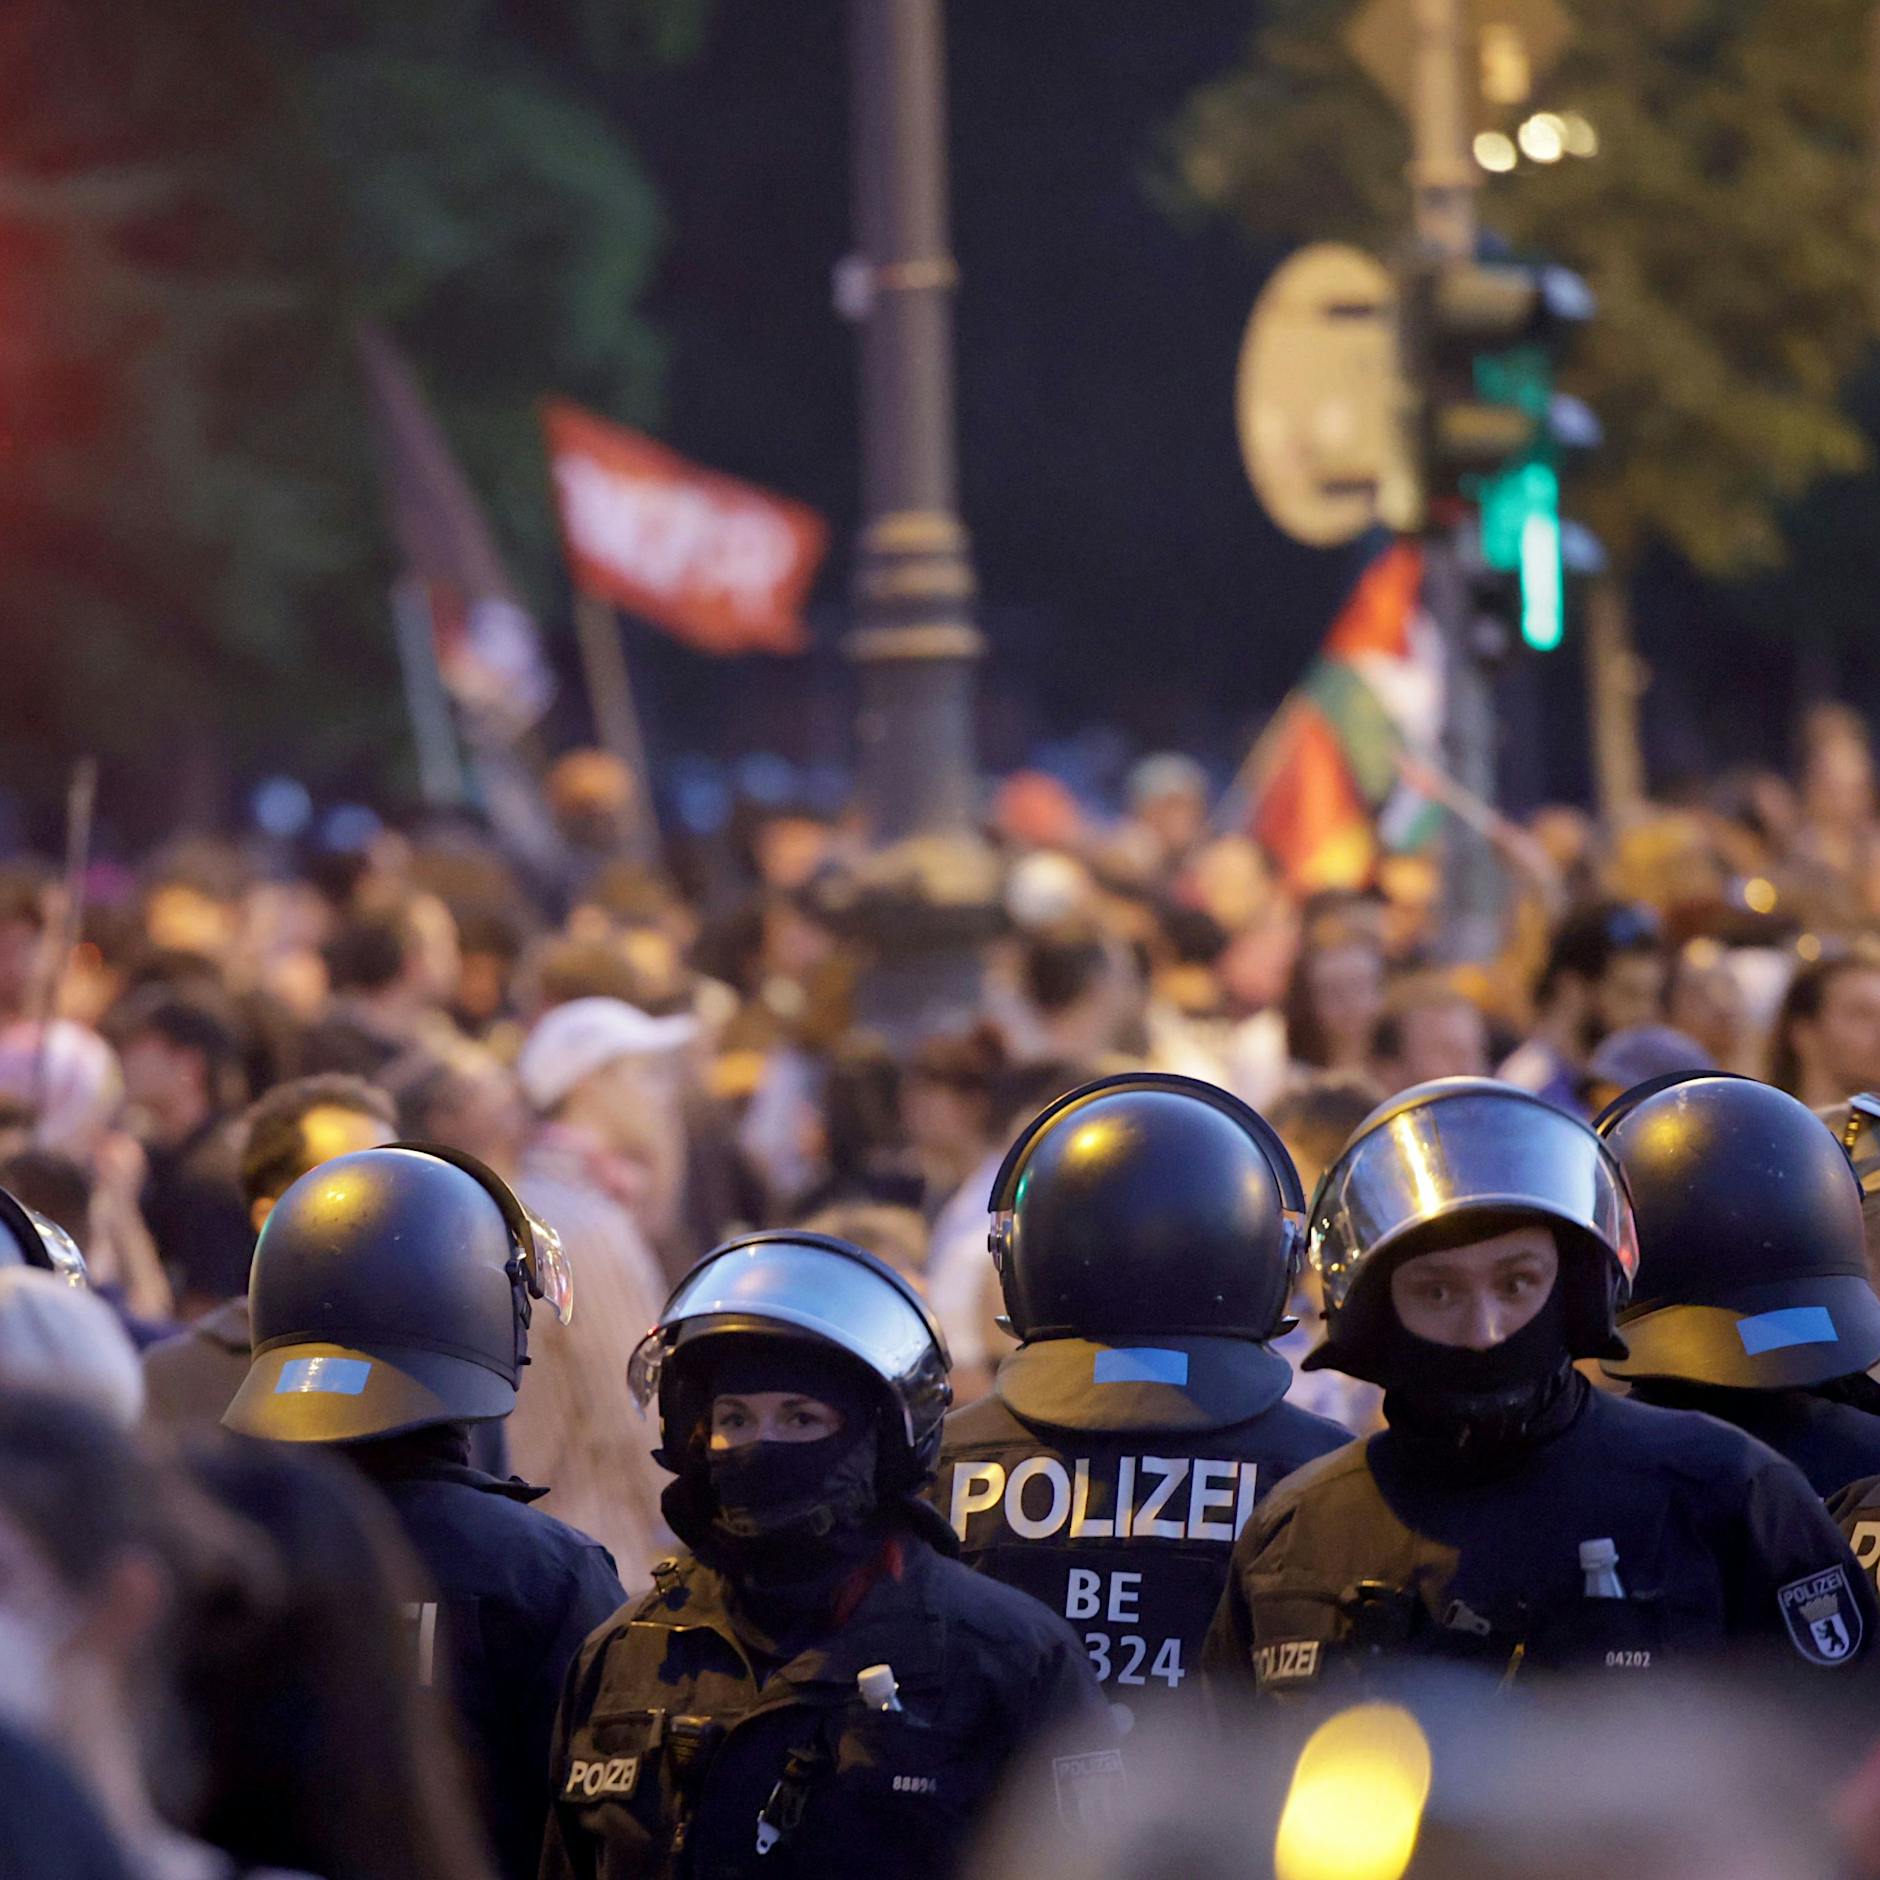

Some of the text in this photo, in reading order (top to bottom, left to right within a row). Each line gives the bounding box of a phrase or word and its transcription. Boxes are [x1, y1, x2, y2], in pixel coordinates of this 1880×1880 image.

[950, 1456, 1257, 1542] POLIZEI
[1065, 1568, 1142, 1623] BE
[1784, 1571, 1842, 1607] POLIZEI
